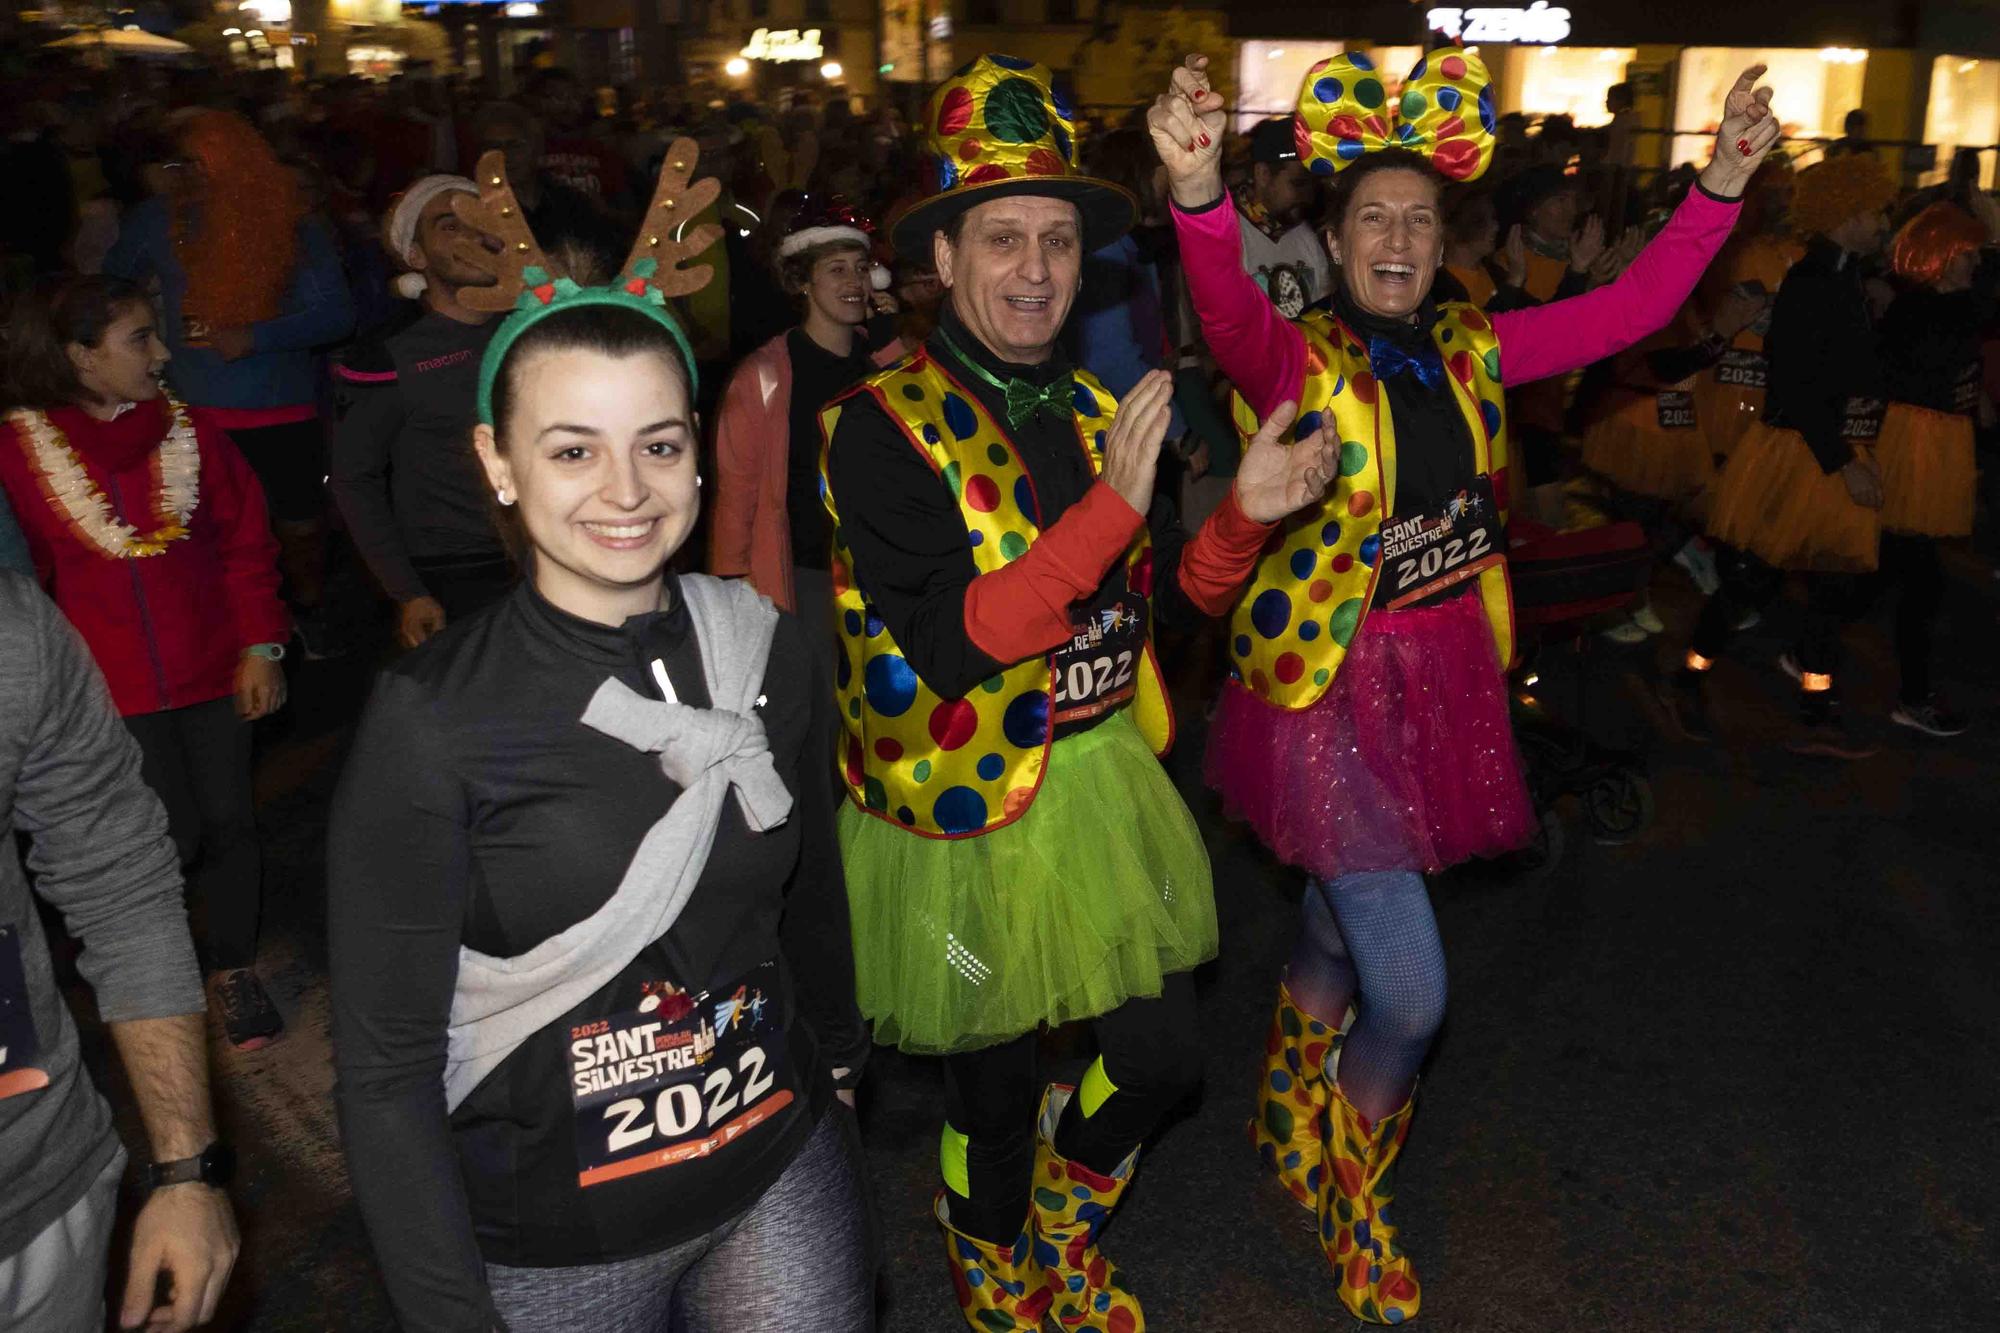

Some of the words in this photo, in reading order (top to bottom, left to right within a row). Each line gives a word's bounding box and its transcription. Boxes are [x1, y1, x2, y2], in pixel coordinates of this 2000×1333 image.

[1720, 367, 1767, 386] 2022
[1382, 514, 1424, 547] SANT
[1397, 527, 1492, 589] 2022
[570, 1022, 662, 1072] SANT
[571, 1020, 610, 1039] 2022
[573, 1045, 697, 1096] SiLVESTRE
[603, 1046, 775, 1153] 2022
